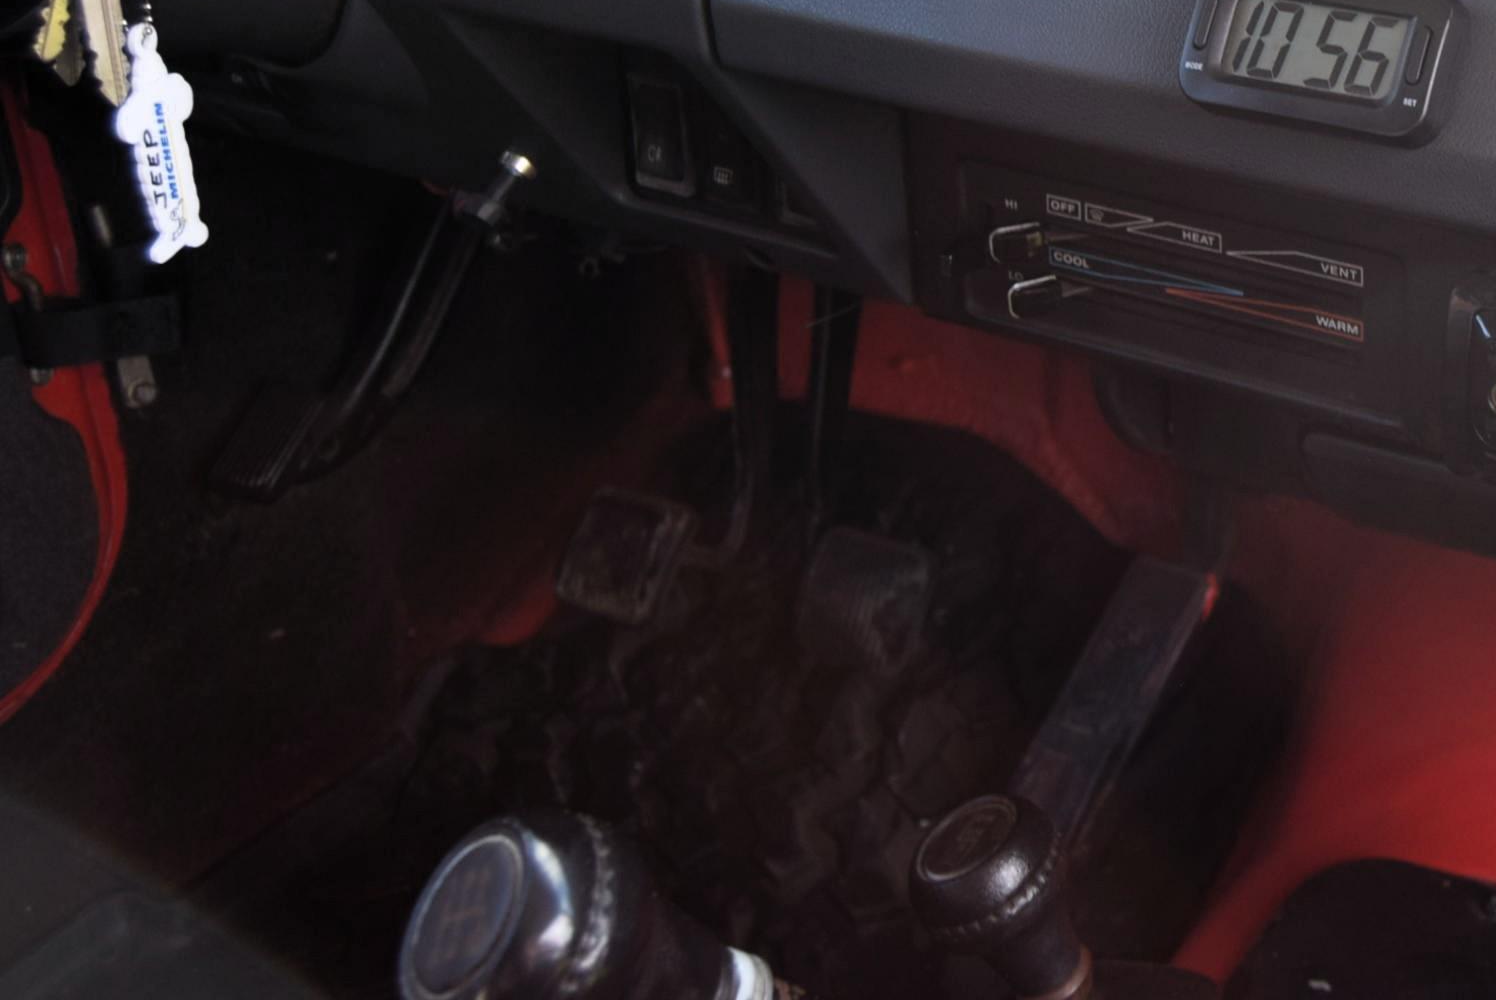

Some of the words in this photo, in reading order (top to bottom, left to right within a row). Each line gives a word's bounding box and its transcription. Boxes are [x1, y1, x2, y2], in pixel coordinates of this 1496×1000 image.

[1303, 10, 1400, 96] 56
[154, 103, 179, 200] MICHELIN
[143, 129, 167, 209] JEEP
[1004, 197, 1019, 211] HI
[1050, 201, 1076, 215] OFF
[1182, 229, 1216, 247] HEAT
[1053, 250, 1090, 269] COOL
[1320, 261, 1358, 280] VENT
[1315, 314, 1359, 335] WARM
